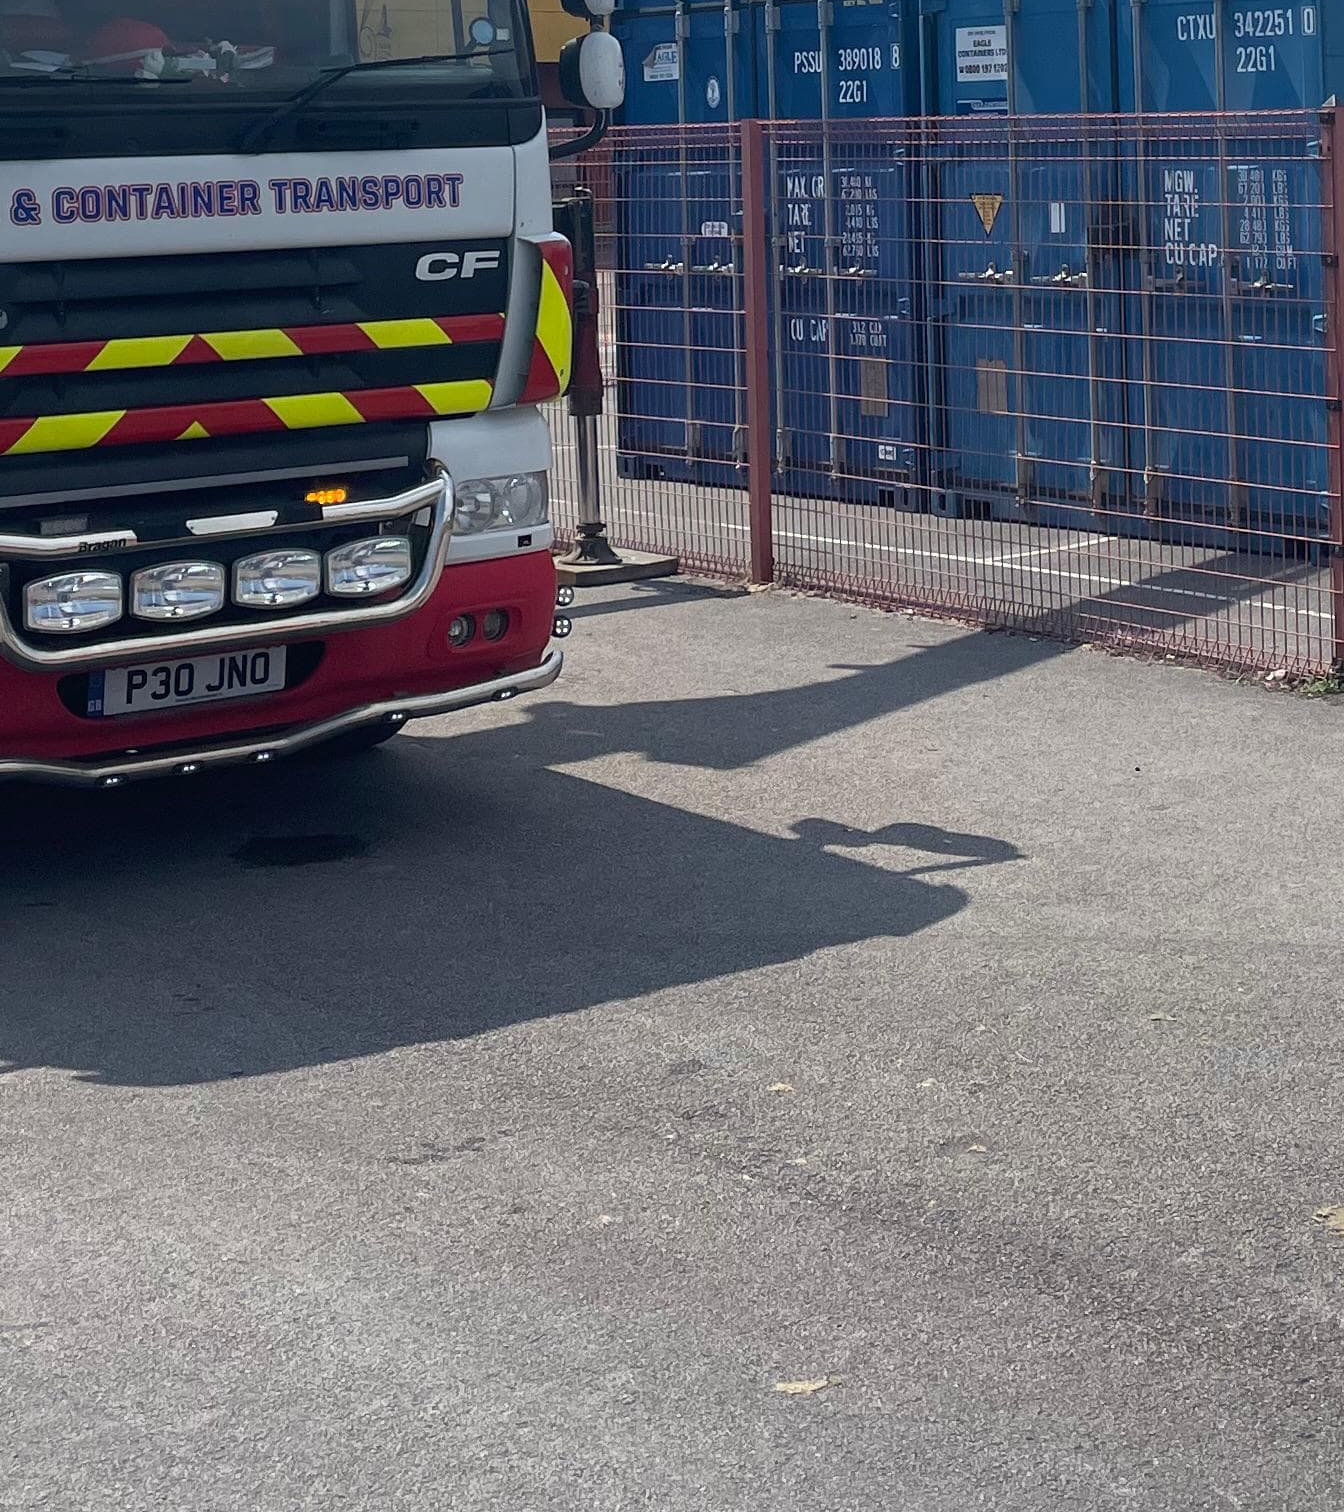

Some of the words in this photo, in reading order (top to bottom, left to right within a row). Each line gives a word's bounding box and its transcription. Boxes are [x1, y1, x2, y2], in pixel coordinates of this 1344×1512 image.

[1177, 14, 1216, 41] CTXU
[1234, 9, 1293, 37] 342251
[1304, 8, 1314, 34] 0
[794, 51, 822, 73] PSSU
[838, 47, 882, 71] 389018
[892, 46, 900, 67] 8
[1236, 45, 1276, 73] 22G1
[839, 80, 867, 103] 22G1
[10, 188, 42, 227] &
[51, 178, 261, 225] CONTAINER
[268, 172, 464, 214] TRANSPORT
[1165, 194, 1199, 217] TARE
[1164, 218, 1191, 241] NET
[414, 249, 502, 283] CF
[78, 538, 127, 554] Bragan
[126, 662, 195, 705] P30
[205, 651, 270, 693] JNO
[87, 699, 102, 713] GB
